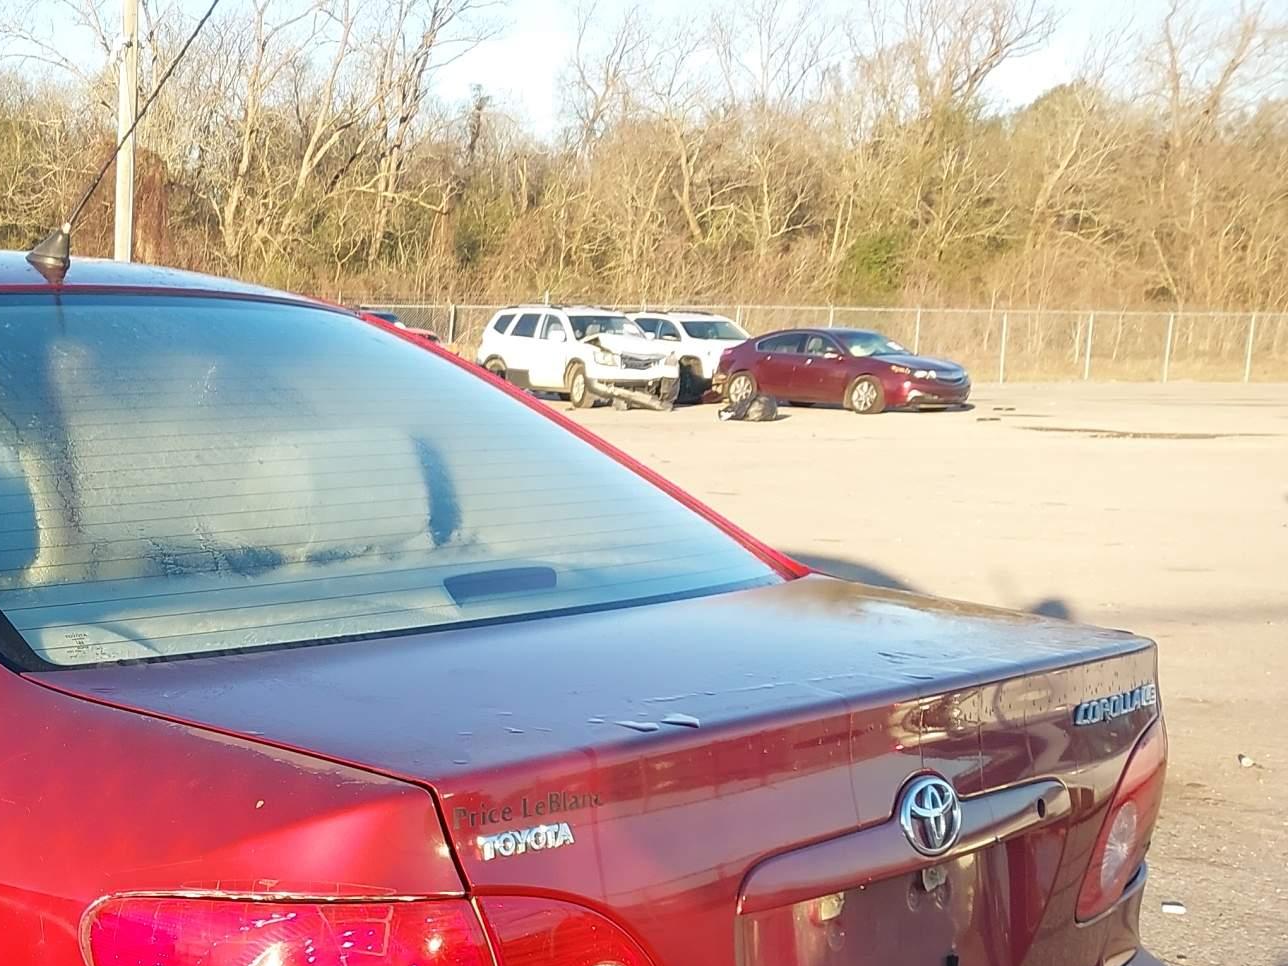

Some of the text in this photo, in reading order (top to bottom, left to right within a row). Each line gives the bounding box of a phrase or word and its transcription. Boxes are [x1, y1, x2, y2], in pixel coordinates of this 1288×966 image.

[1074, 683, 1156, 725] COROLLA LE
[452, 791, 604, 830] Price LeBlanc
[477, 822, 575, 861] TOYOTA
